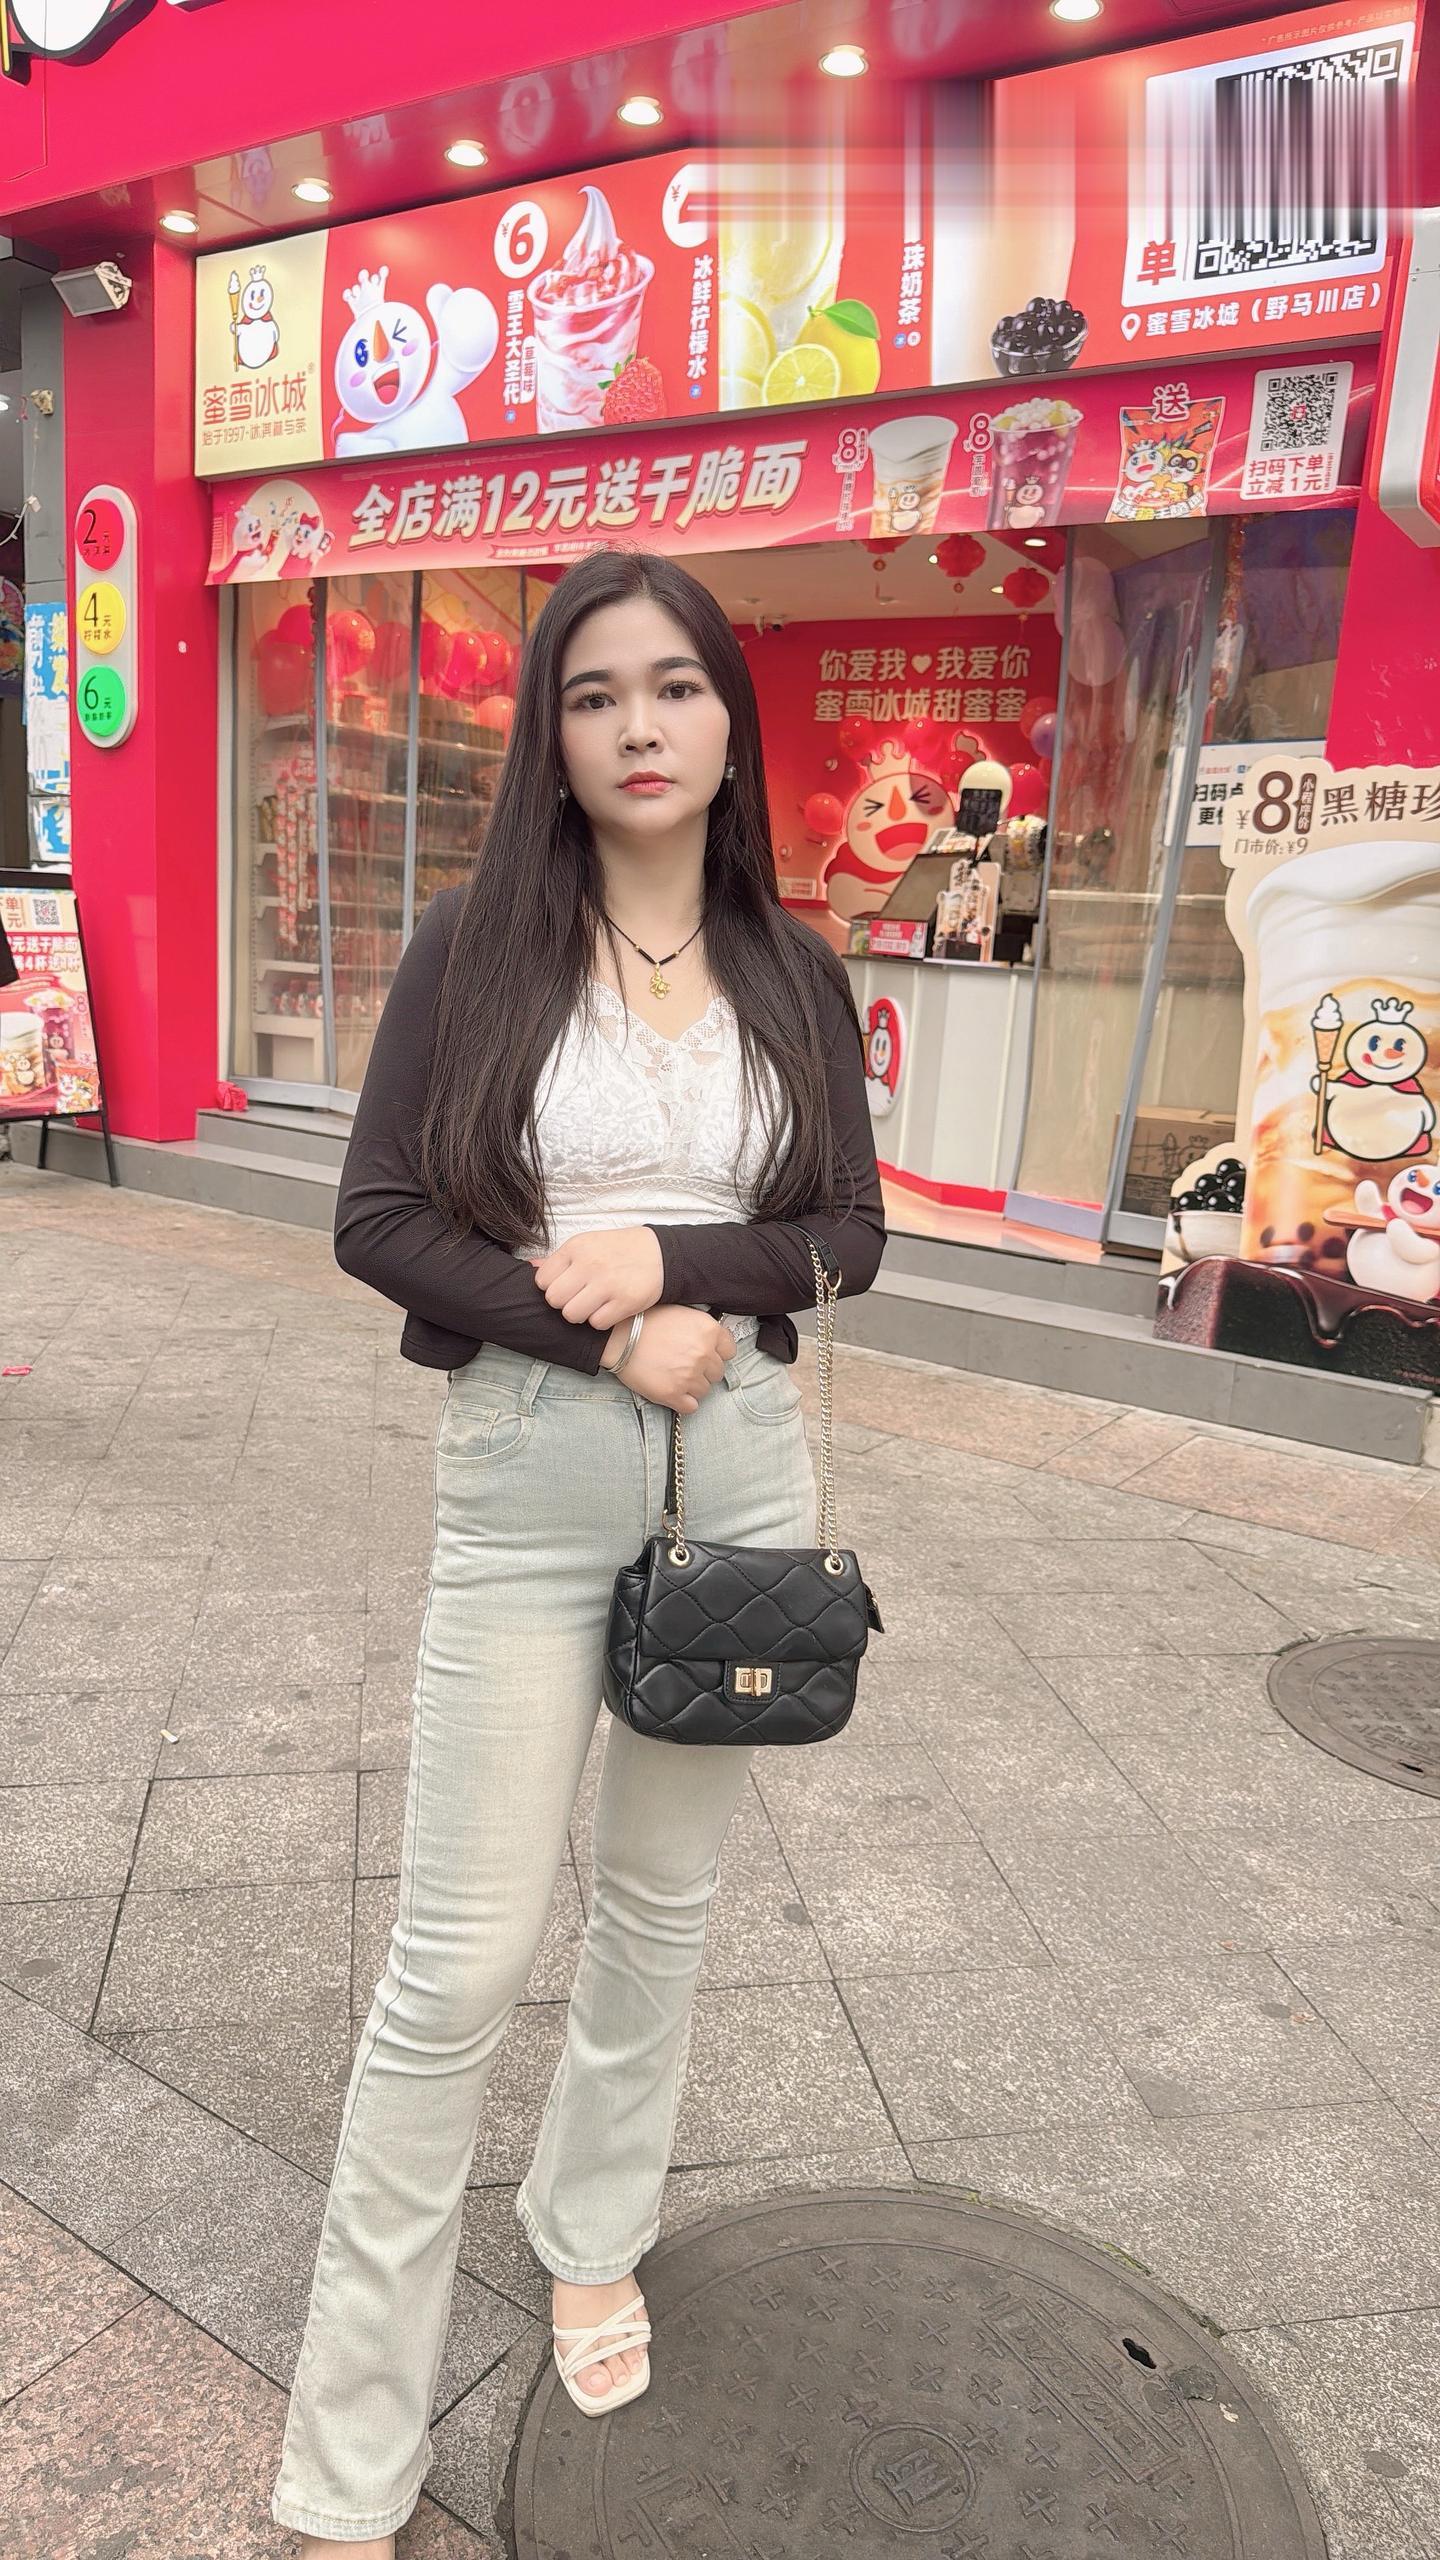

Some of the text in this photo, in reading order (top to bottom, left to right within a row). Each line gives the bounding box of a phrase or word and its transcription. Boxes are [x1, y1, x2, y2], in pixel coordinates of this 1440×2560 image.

[687, 254, 714, 379] 冰鲜柠檬水
[502, 289, 525, 405] 雪王大圣代
[203, 371, 307, 426] 蜜雪冰城
[1152, 383, 1190, 421] 送
[1246, 473, 1322, 495] 立减1元
[1249, 454, 1324, 478] 扫码下单
[348, 440, 809, 552] 全店满12元送干脆面
[814, 688, 1027, 722] 蜜雪冰城甜蜜蜜
[1298, 778, 1316, 831] 小程序价
[1320, 780, 1440, 827] 黑糖珍
